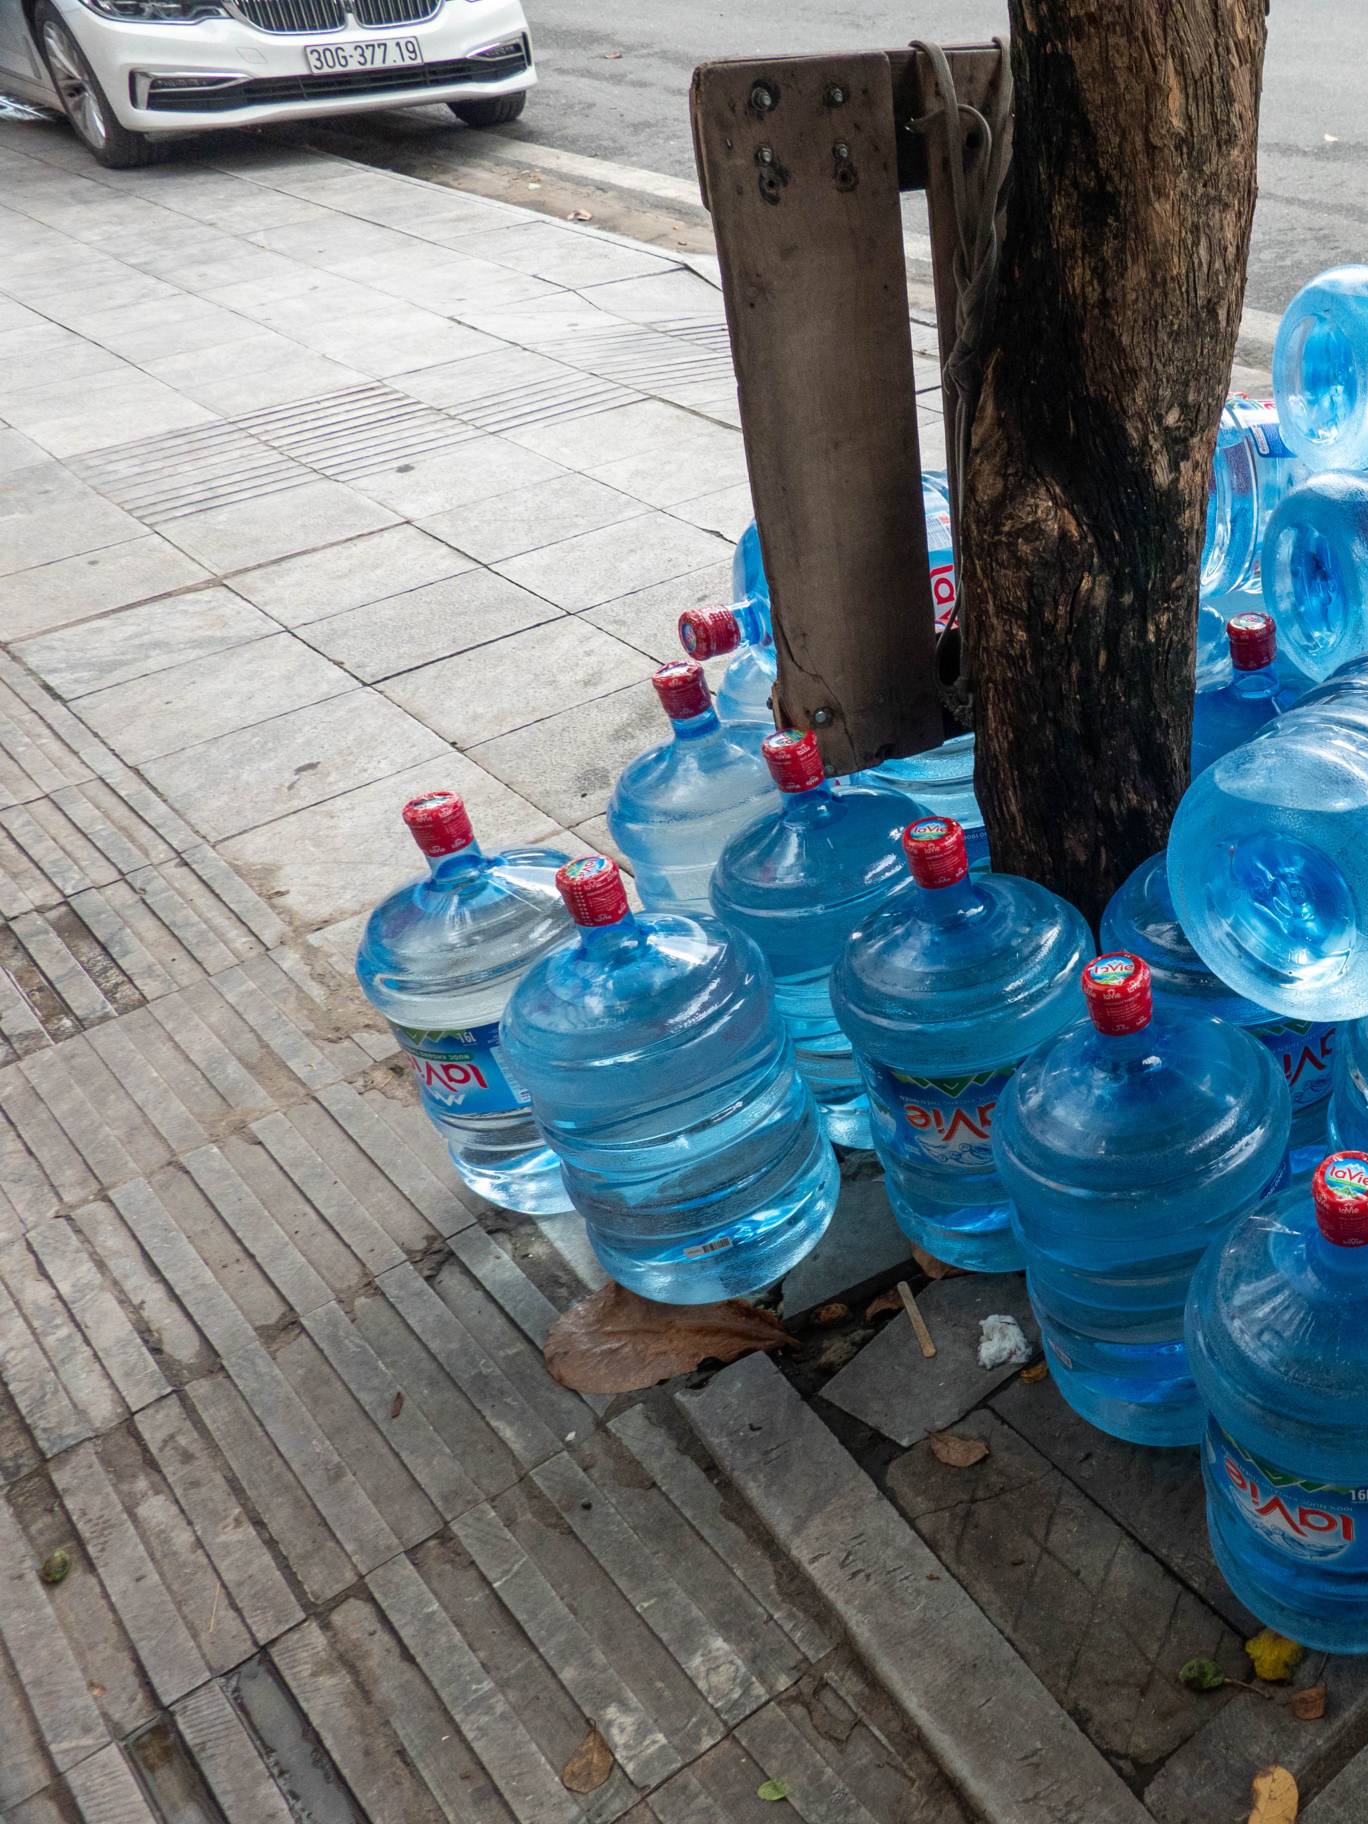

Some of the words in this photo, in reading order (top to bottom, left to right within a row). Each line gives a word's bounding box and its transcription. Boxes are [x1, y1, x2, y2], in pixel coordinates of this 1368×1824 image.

[310, 40, 418, 71] 30G-377.19
[1093, 961, 1134, 974] laVie
[1223, 1456, 1355, 1542] laVie
